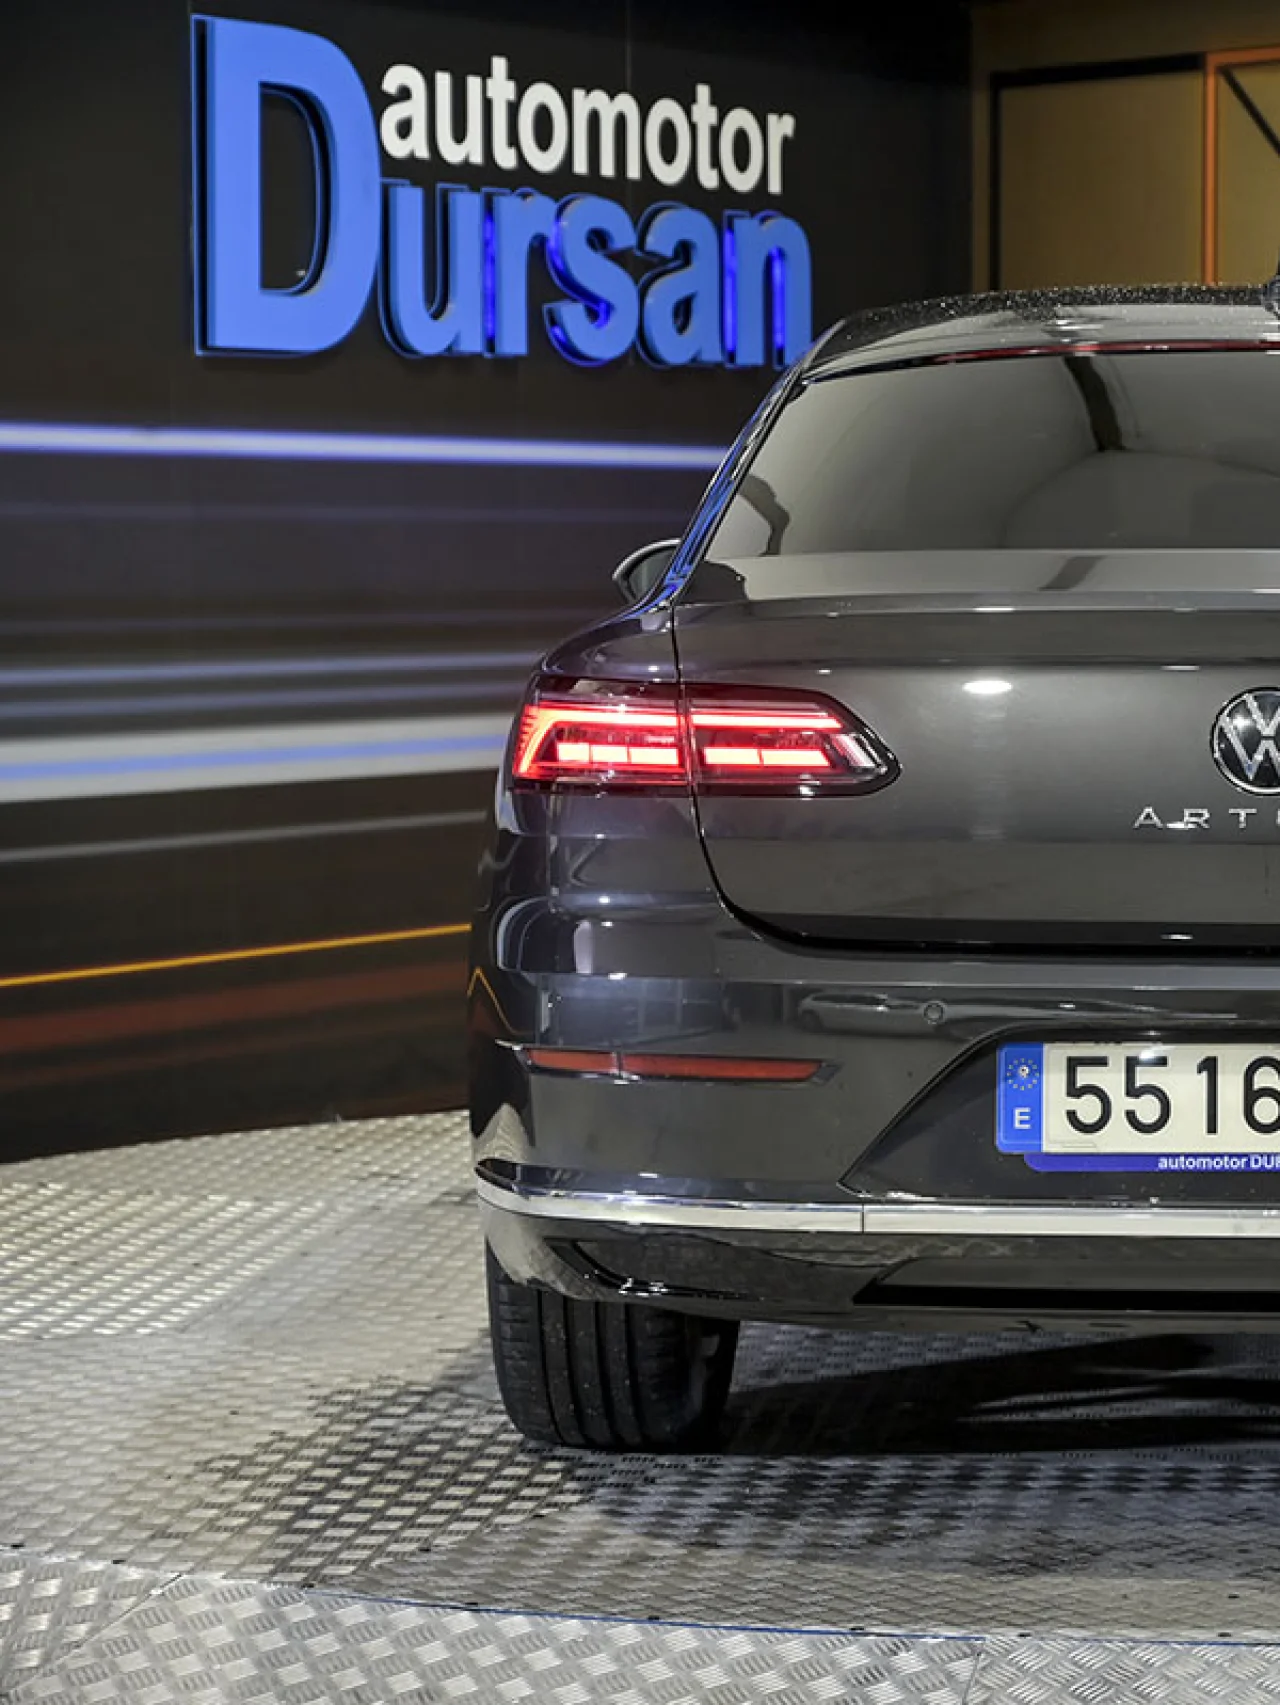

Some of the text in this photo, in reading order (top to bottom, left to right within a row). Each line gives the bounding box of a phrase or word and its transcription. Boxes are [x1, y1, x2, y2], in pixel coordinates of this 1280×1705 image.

[191, 13, 813, 367] Dursan
[380, 56, 795, 195] automotor
[1013, 1106, 1031, 1130] E
